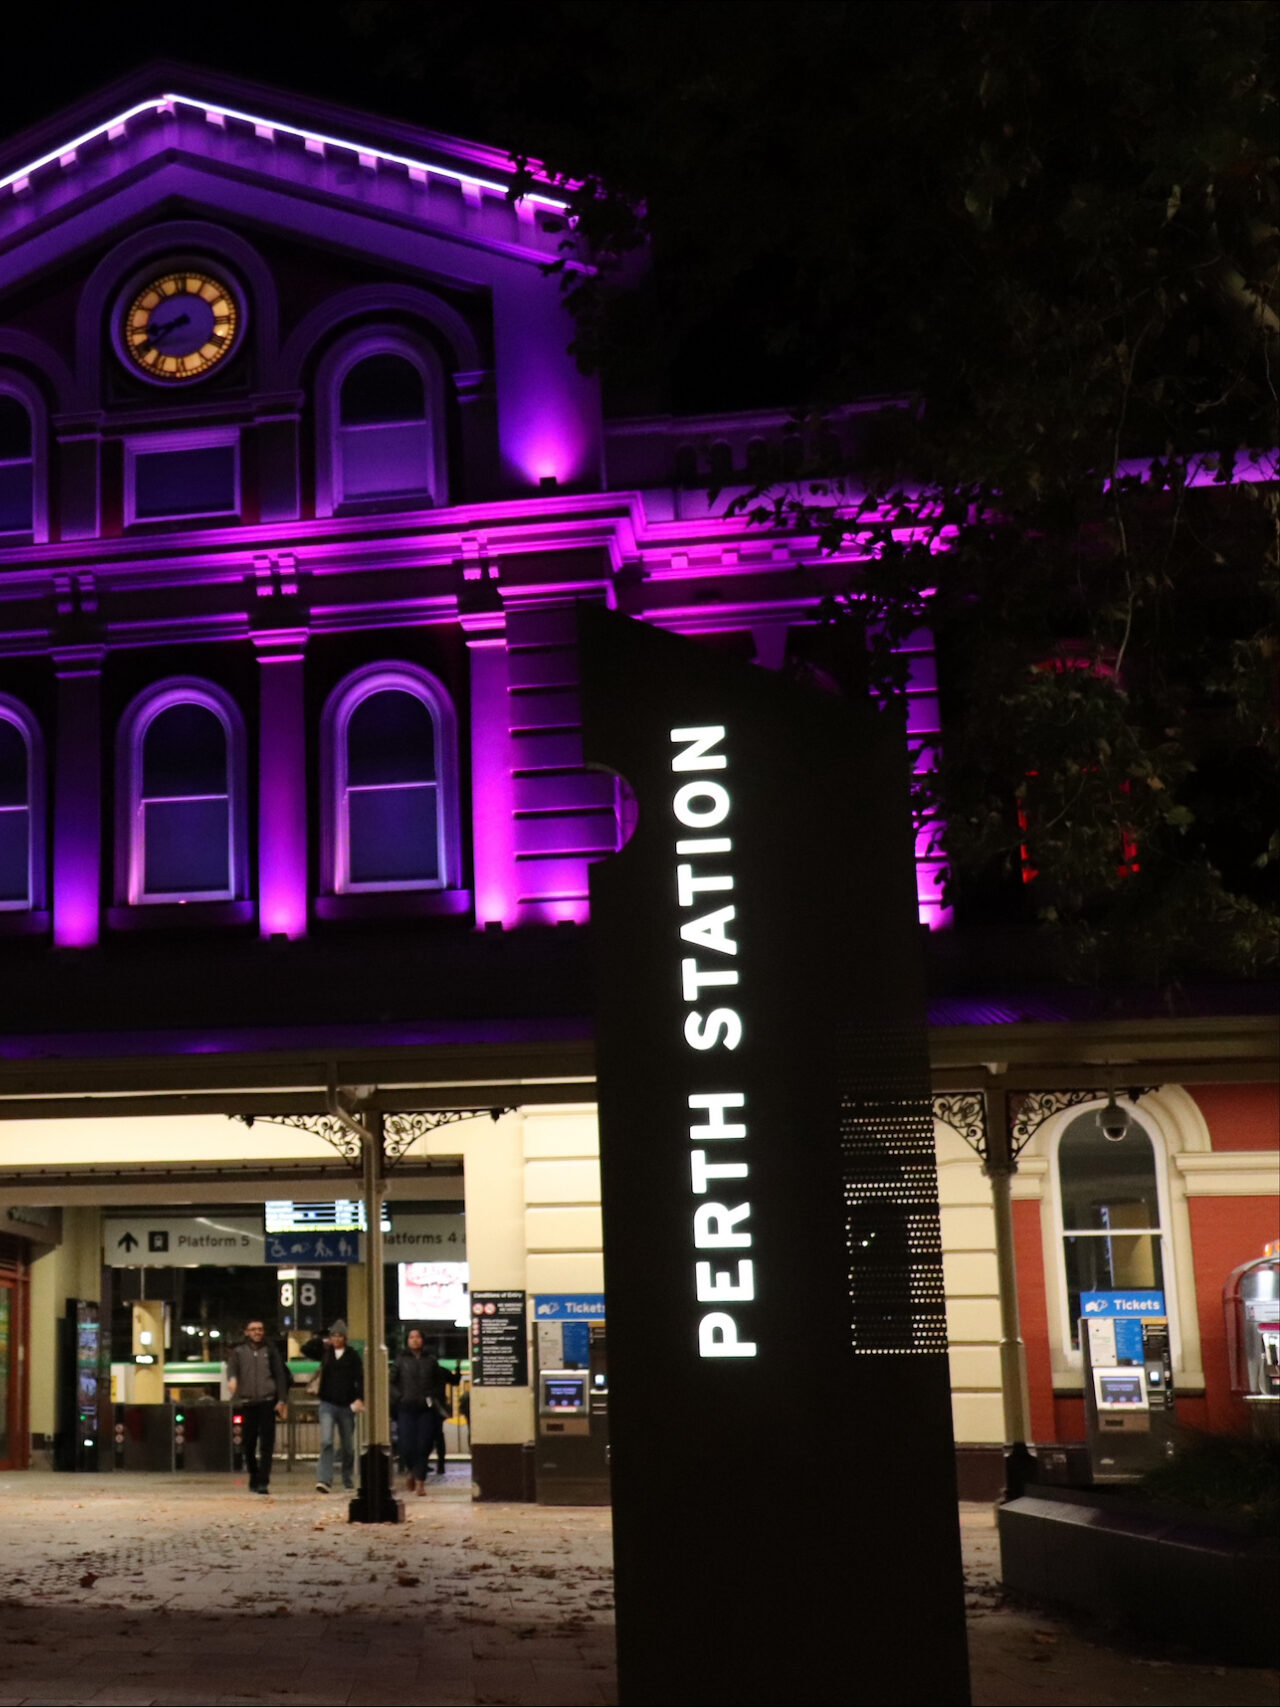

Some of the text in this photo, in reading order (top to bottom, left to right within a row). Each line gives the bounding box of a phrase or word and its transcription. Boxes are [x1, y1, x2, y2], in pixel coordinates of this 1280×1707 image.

[670, 725, 757, 1357] PERTH STATION
[178, 1235, 250, 1248] Platform 5
[383, 1232, 442, 1245] latforms
[448, 1231, 457, 1244] 4
[280, 1283, 293, 1307] 8
[300, 1283, 317, 1306] 8
[1113, 1299, 1160, 1311] Tickets
